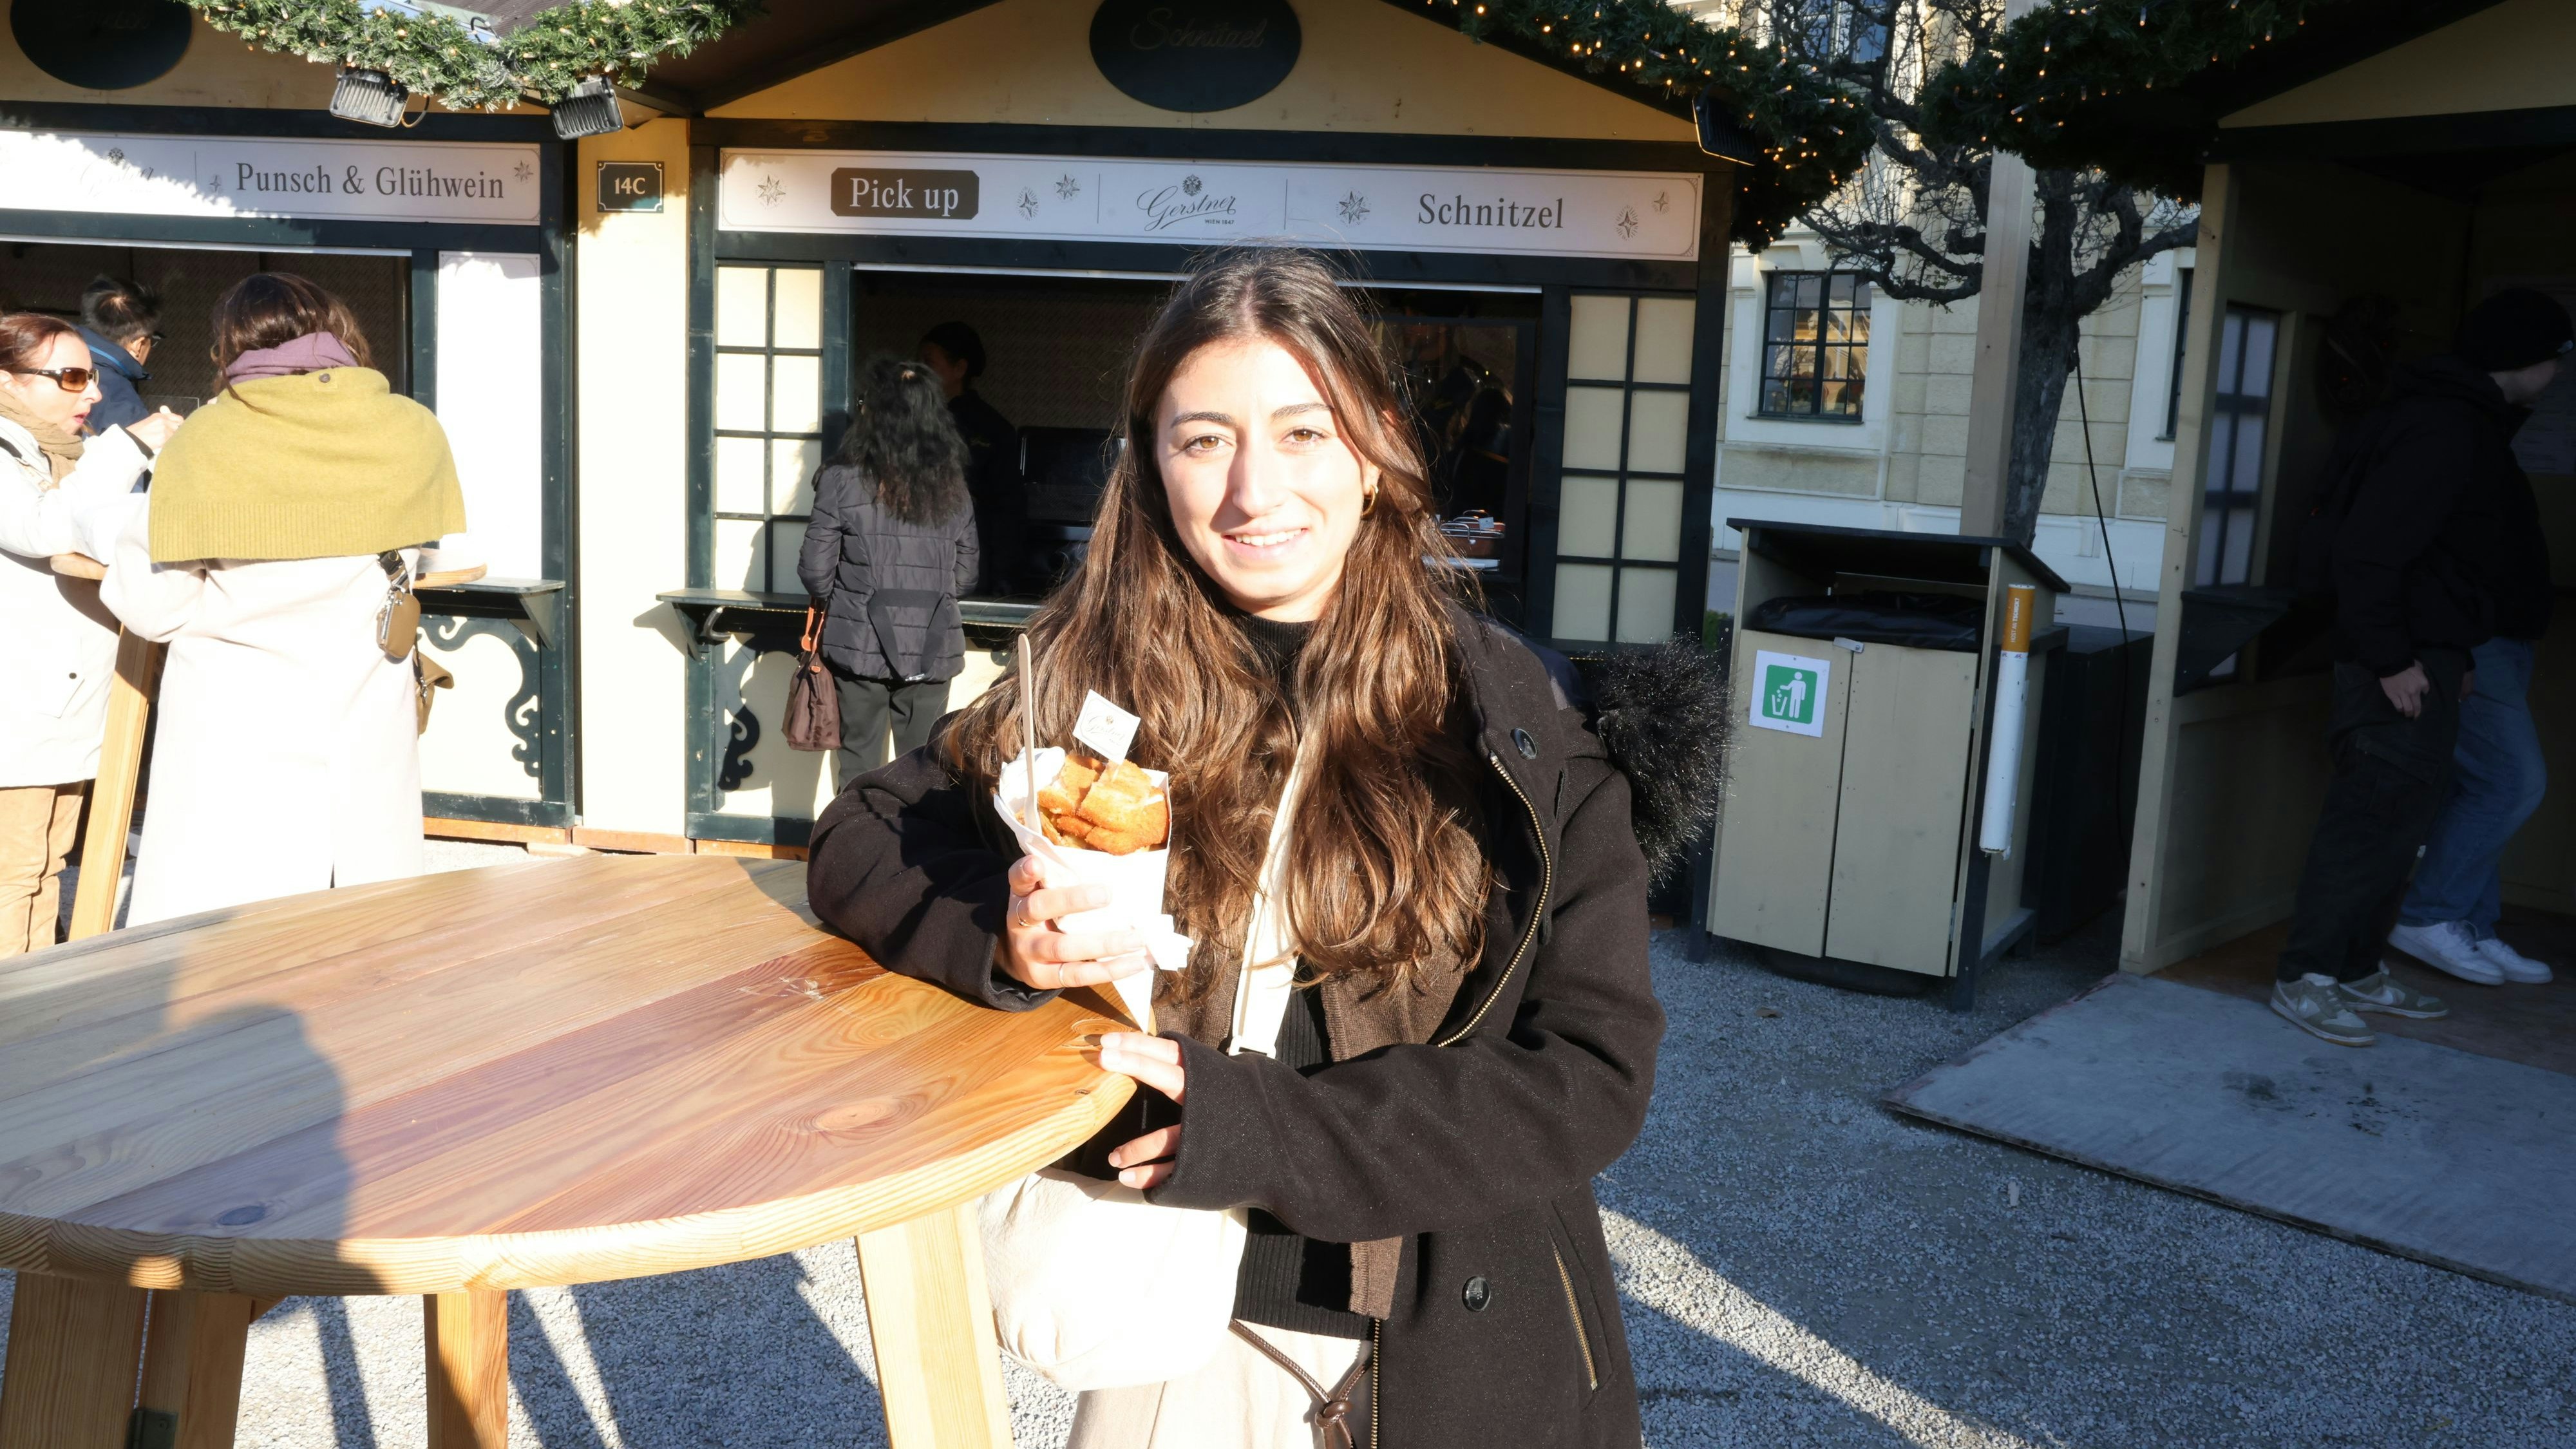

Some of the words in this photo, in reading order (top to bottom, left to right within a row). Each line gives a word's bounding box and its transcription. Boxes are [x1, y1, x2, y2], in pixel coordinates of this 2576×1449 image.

[1130, 7, 1267, 50] Schnitzel
[236, 162, 332, 193] Punsch
[342, 165, 365, 194] &
[375, 166, 504, 198] Glühwein
[614, 176, 646, 195] 14C
[849, 177, 914, 209] Pick
[923, 188, 959, 217] up
[1137, 185, 1236, 232] Gerstner
[1418, 193, 1564, 229] Schnitzel
